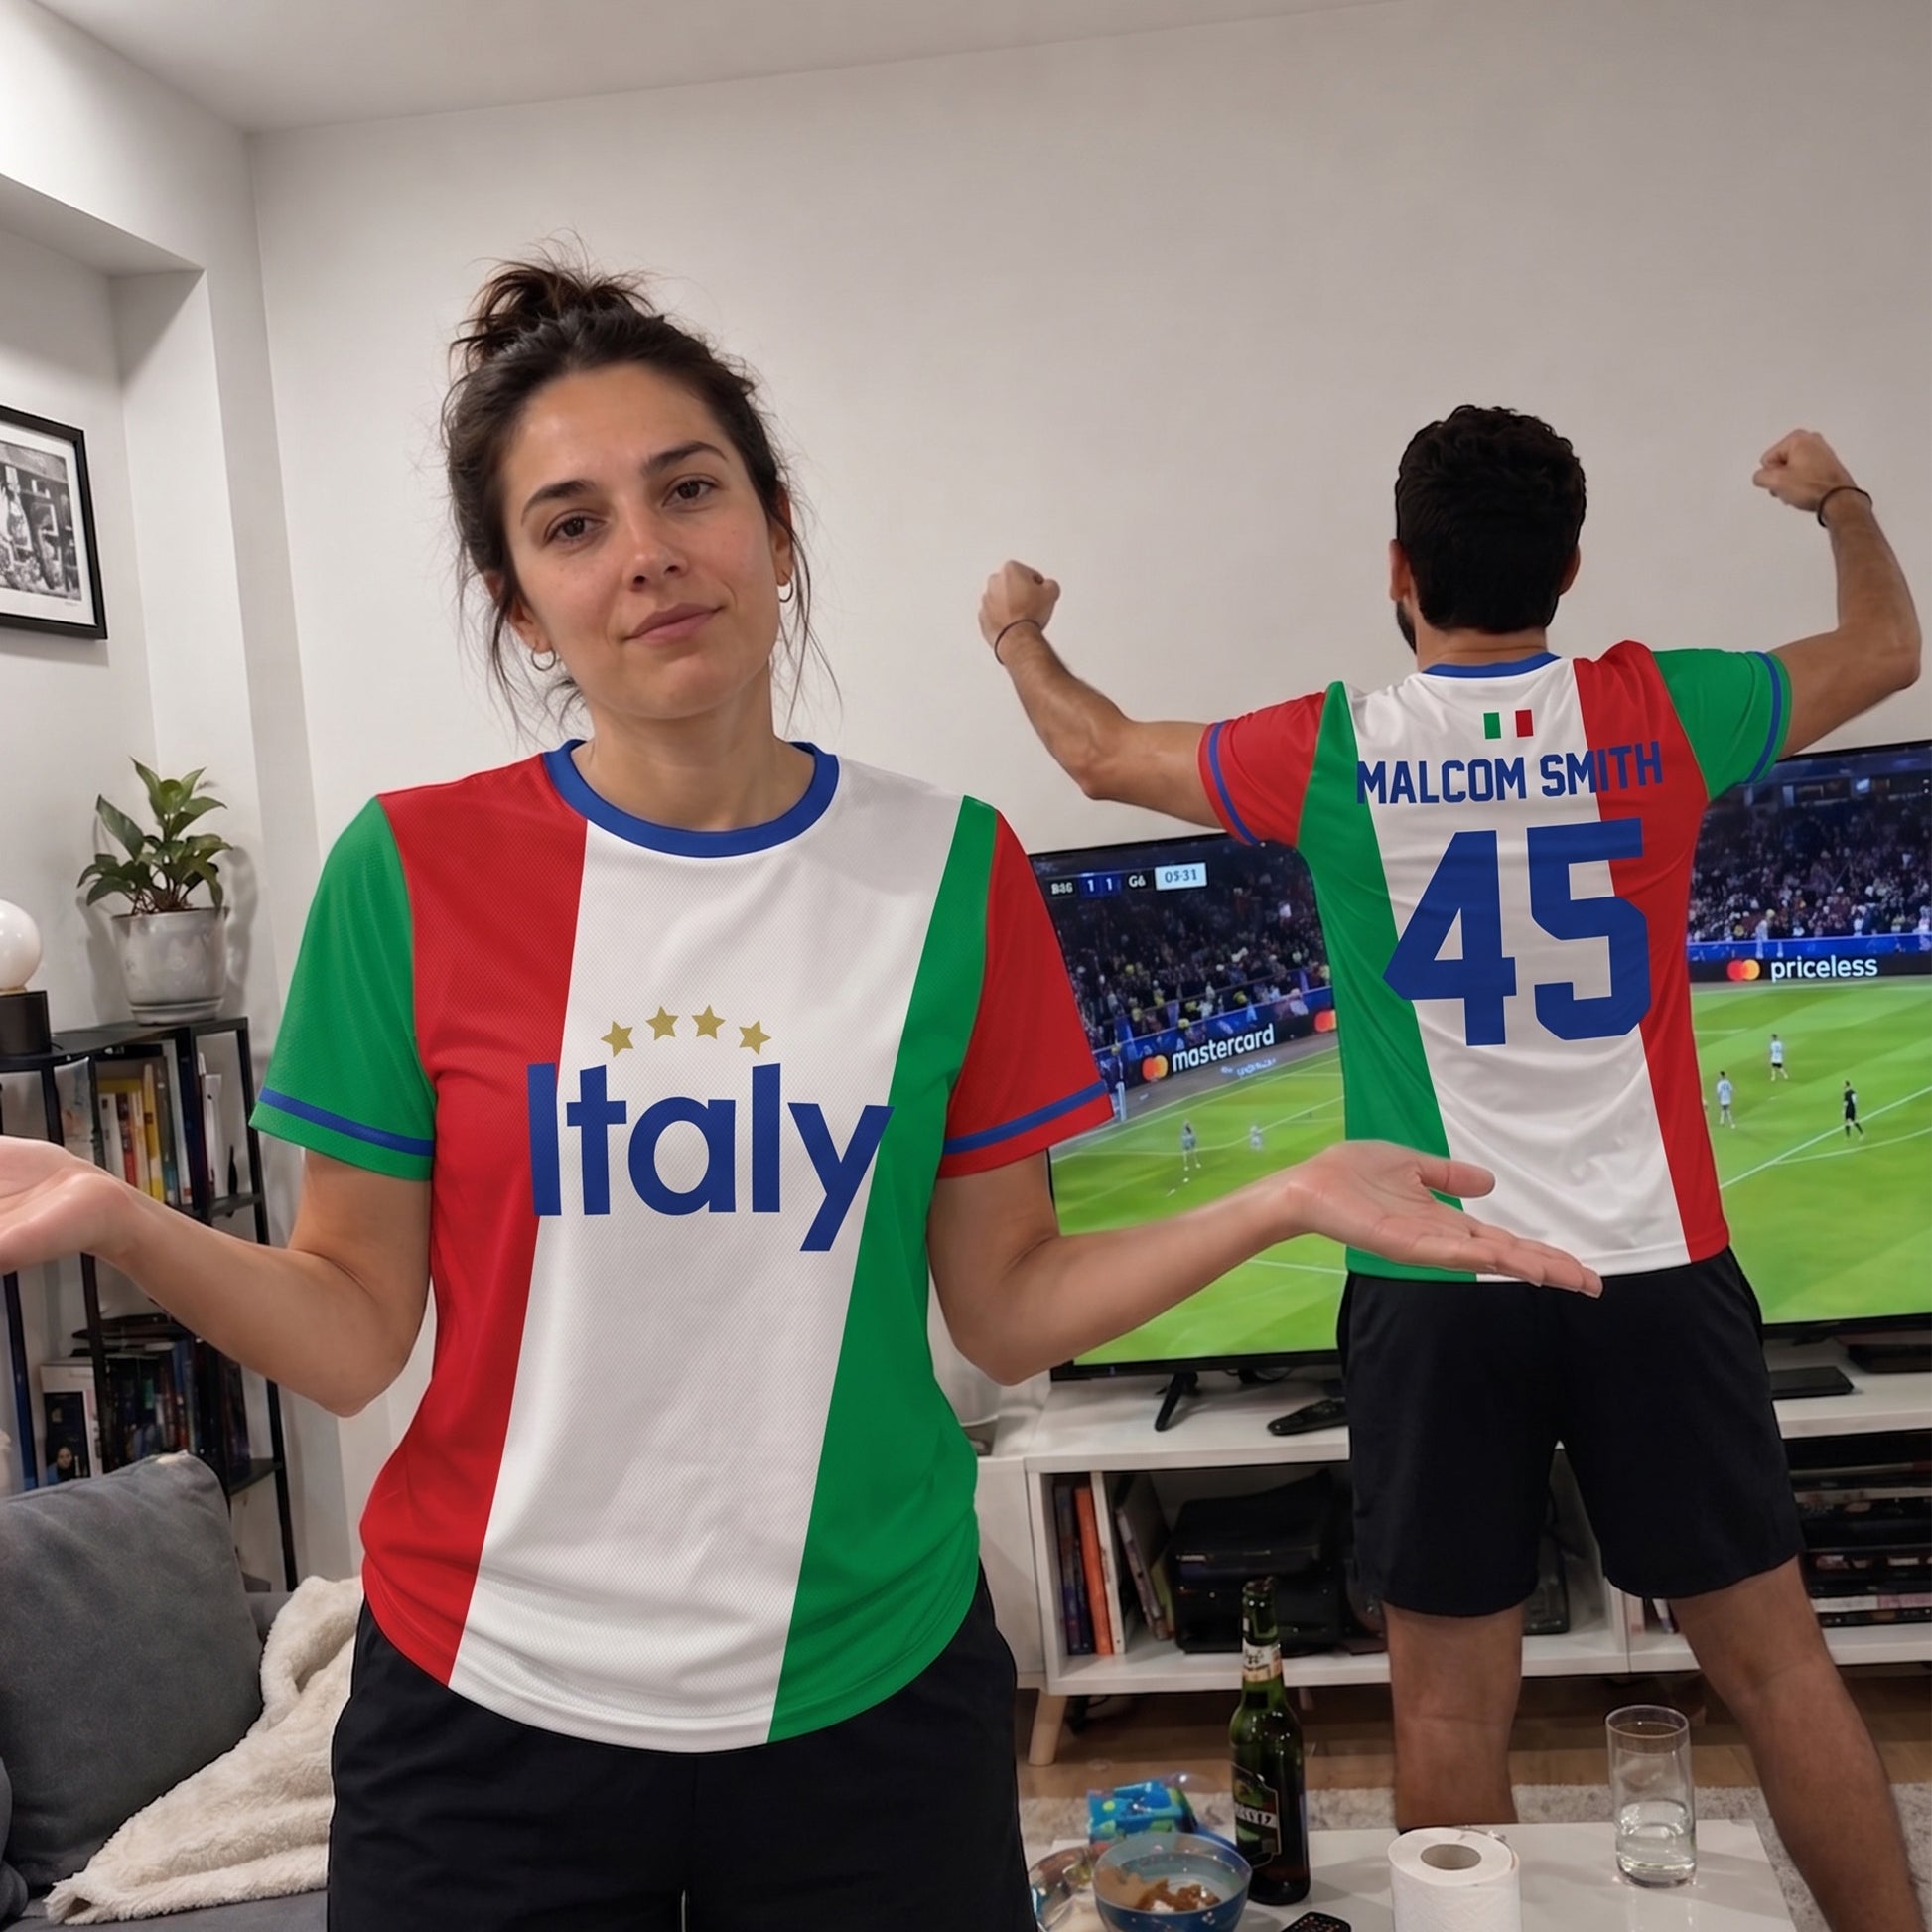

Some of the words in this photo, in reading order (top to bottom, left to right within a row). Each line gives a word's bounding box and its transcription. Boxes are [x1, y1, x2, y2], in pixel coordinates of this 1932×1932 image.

[1356, 757, 1527, 804] MALCOM
[1540, 741, 1663, 797] SMITH
[1382, 817, 1652, 1046] 45
[1770, 955, 1878, 983] priceless
[1172, 1023, 1275, 1072] mastercard
[527, 1062, 895, 1252] Italy
